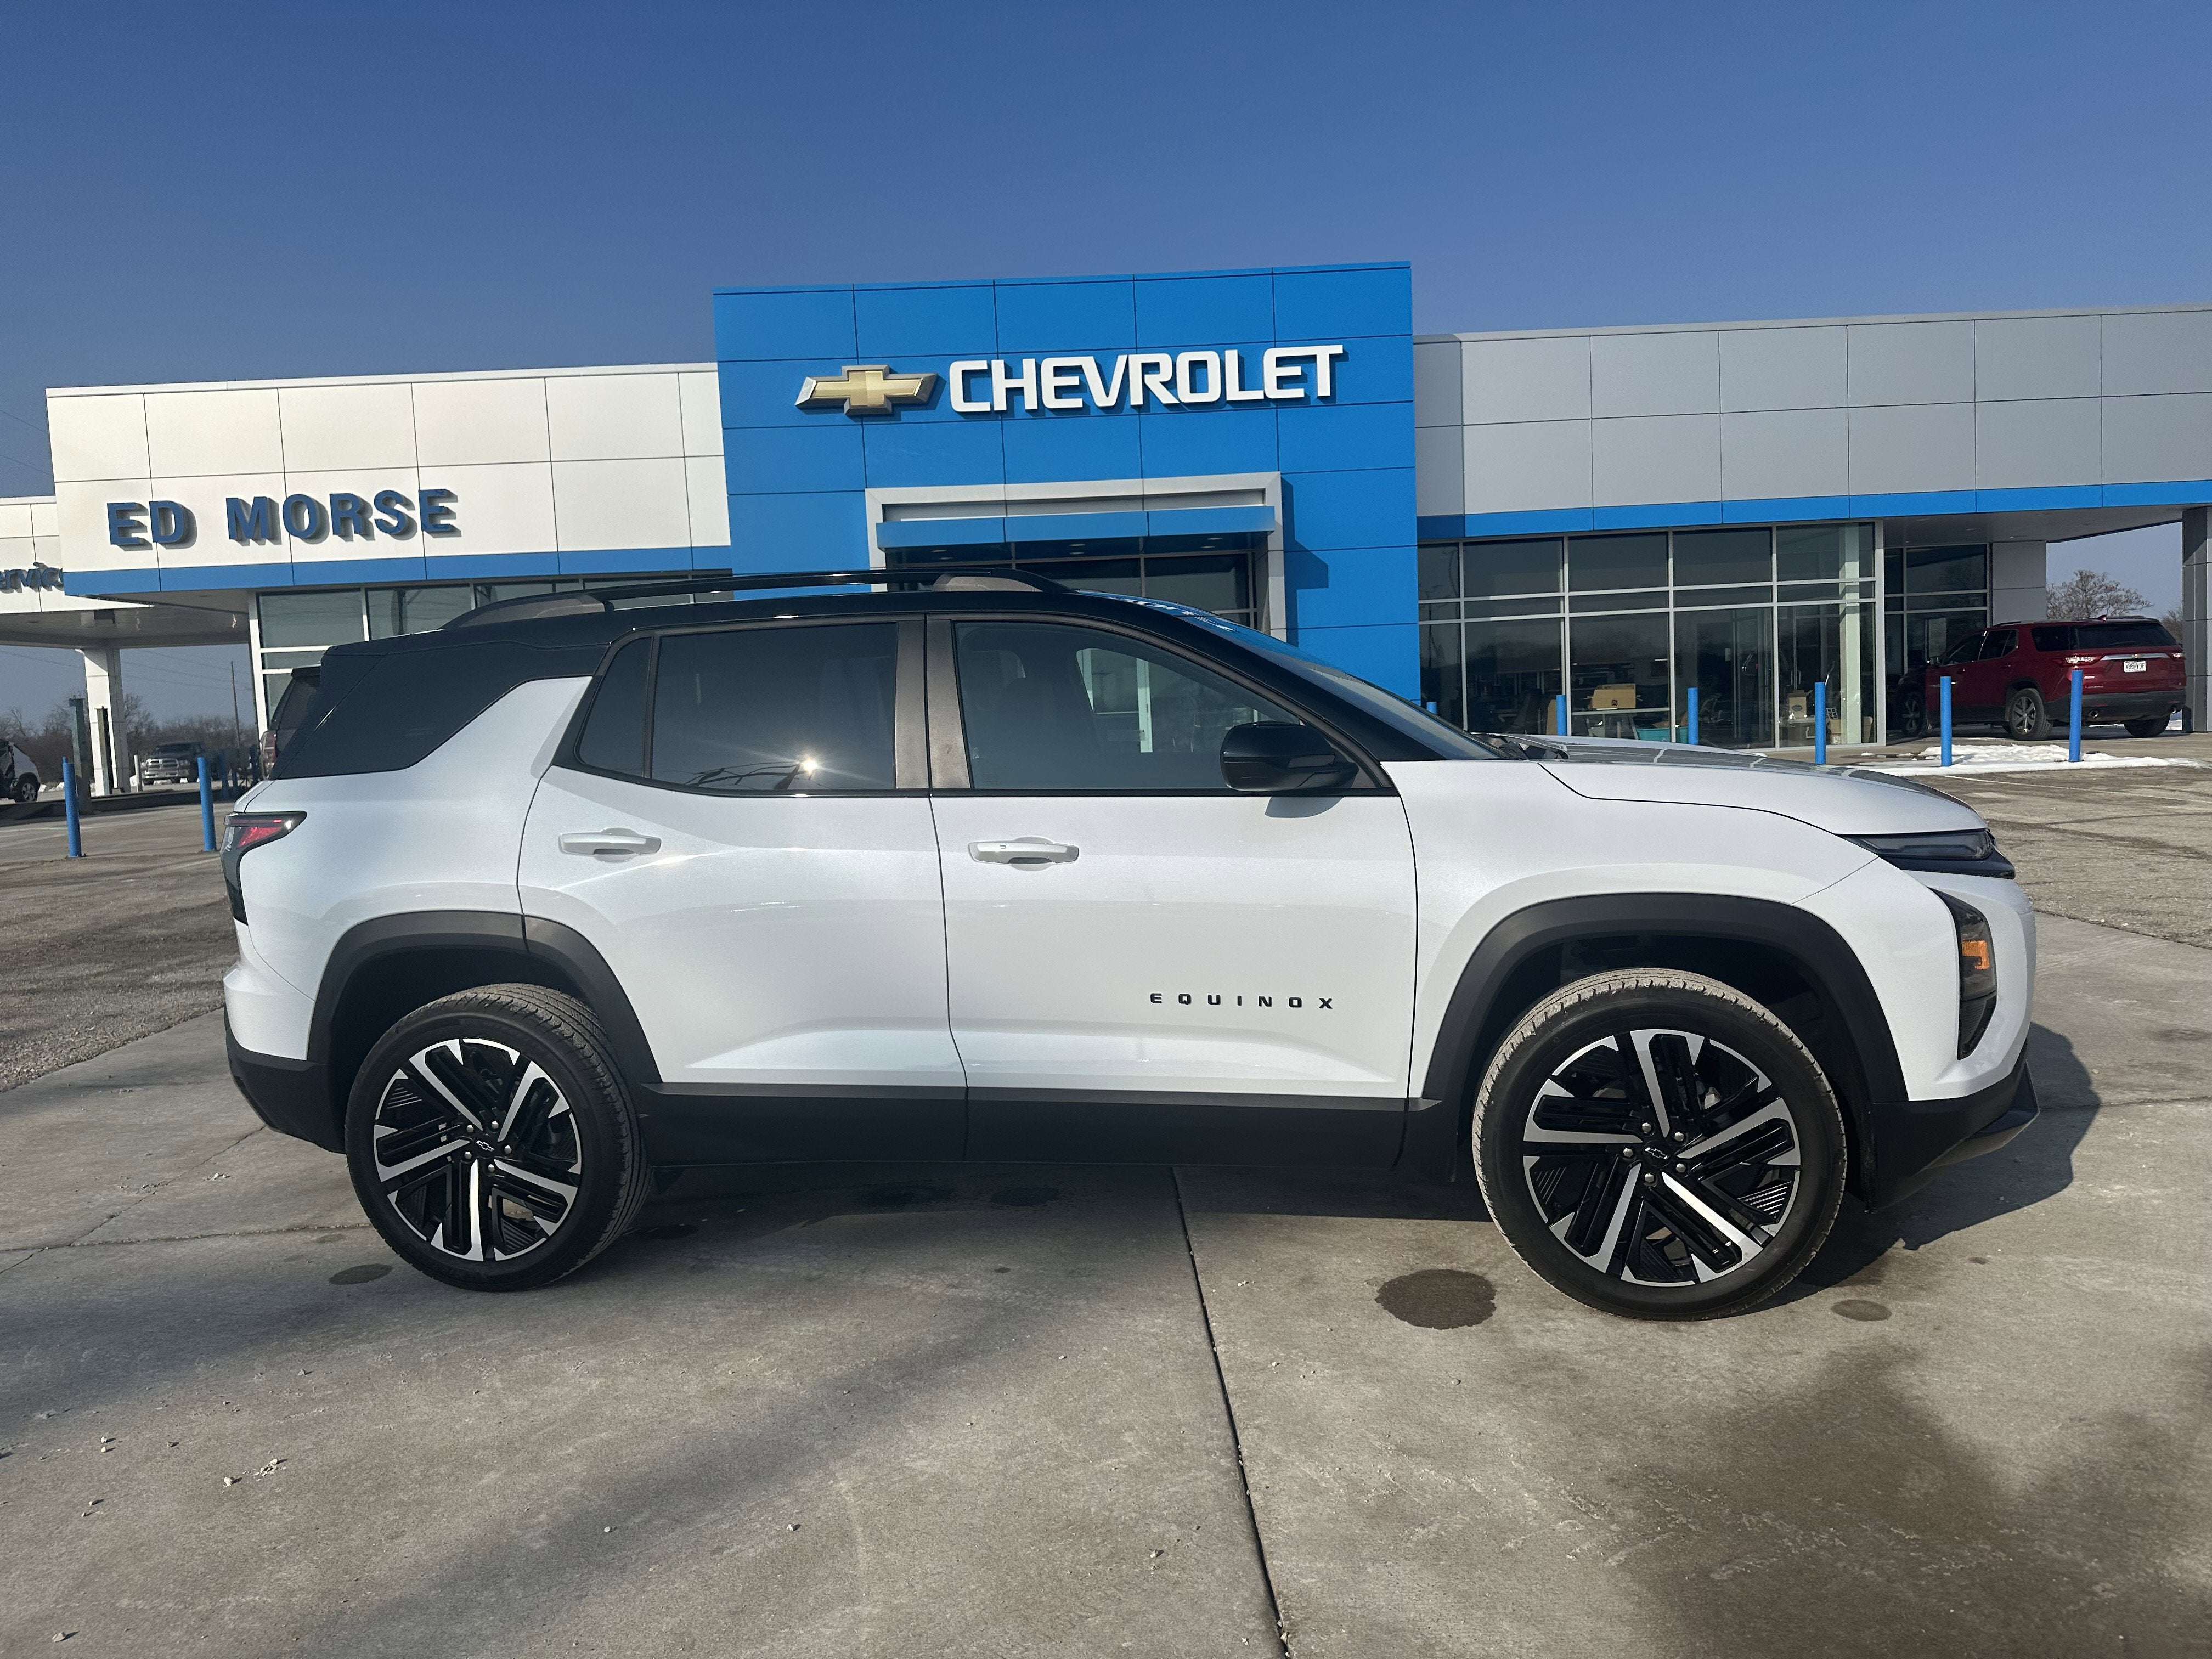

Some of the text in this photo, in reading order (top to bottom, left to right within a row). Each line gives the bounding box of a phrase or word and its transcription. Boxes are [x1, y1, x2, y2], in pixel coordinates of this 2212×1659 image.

[949, 344, 1344, 413] CHEVROLET
[107, 489, 453, 546] ED MORSE
[0, 562, 64, 589] rvic
[1150, 992, 1333, 1009] EQUINOX
